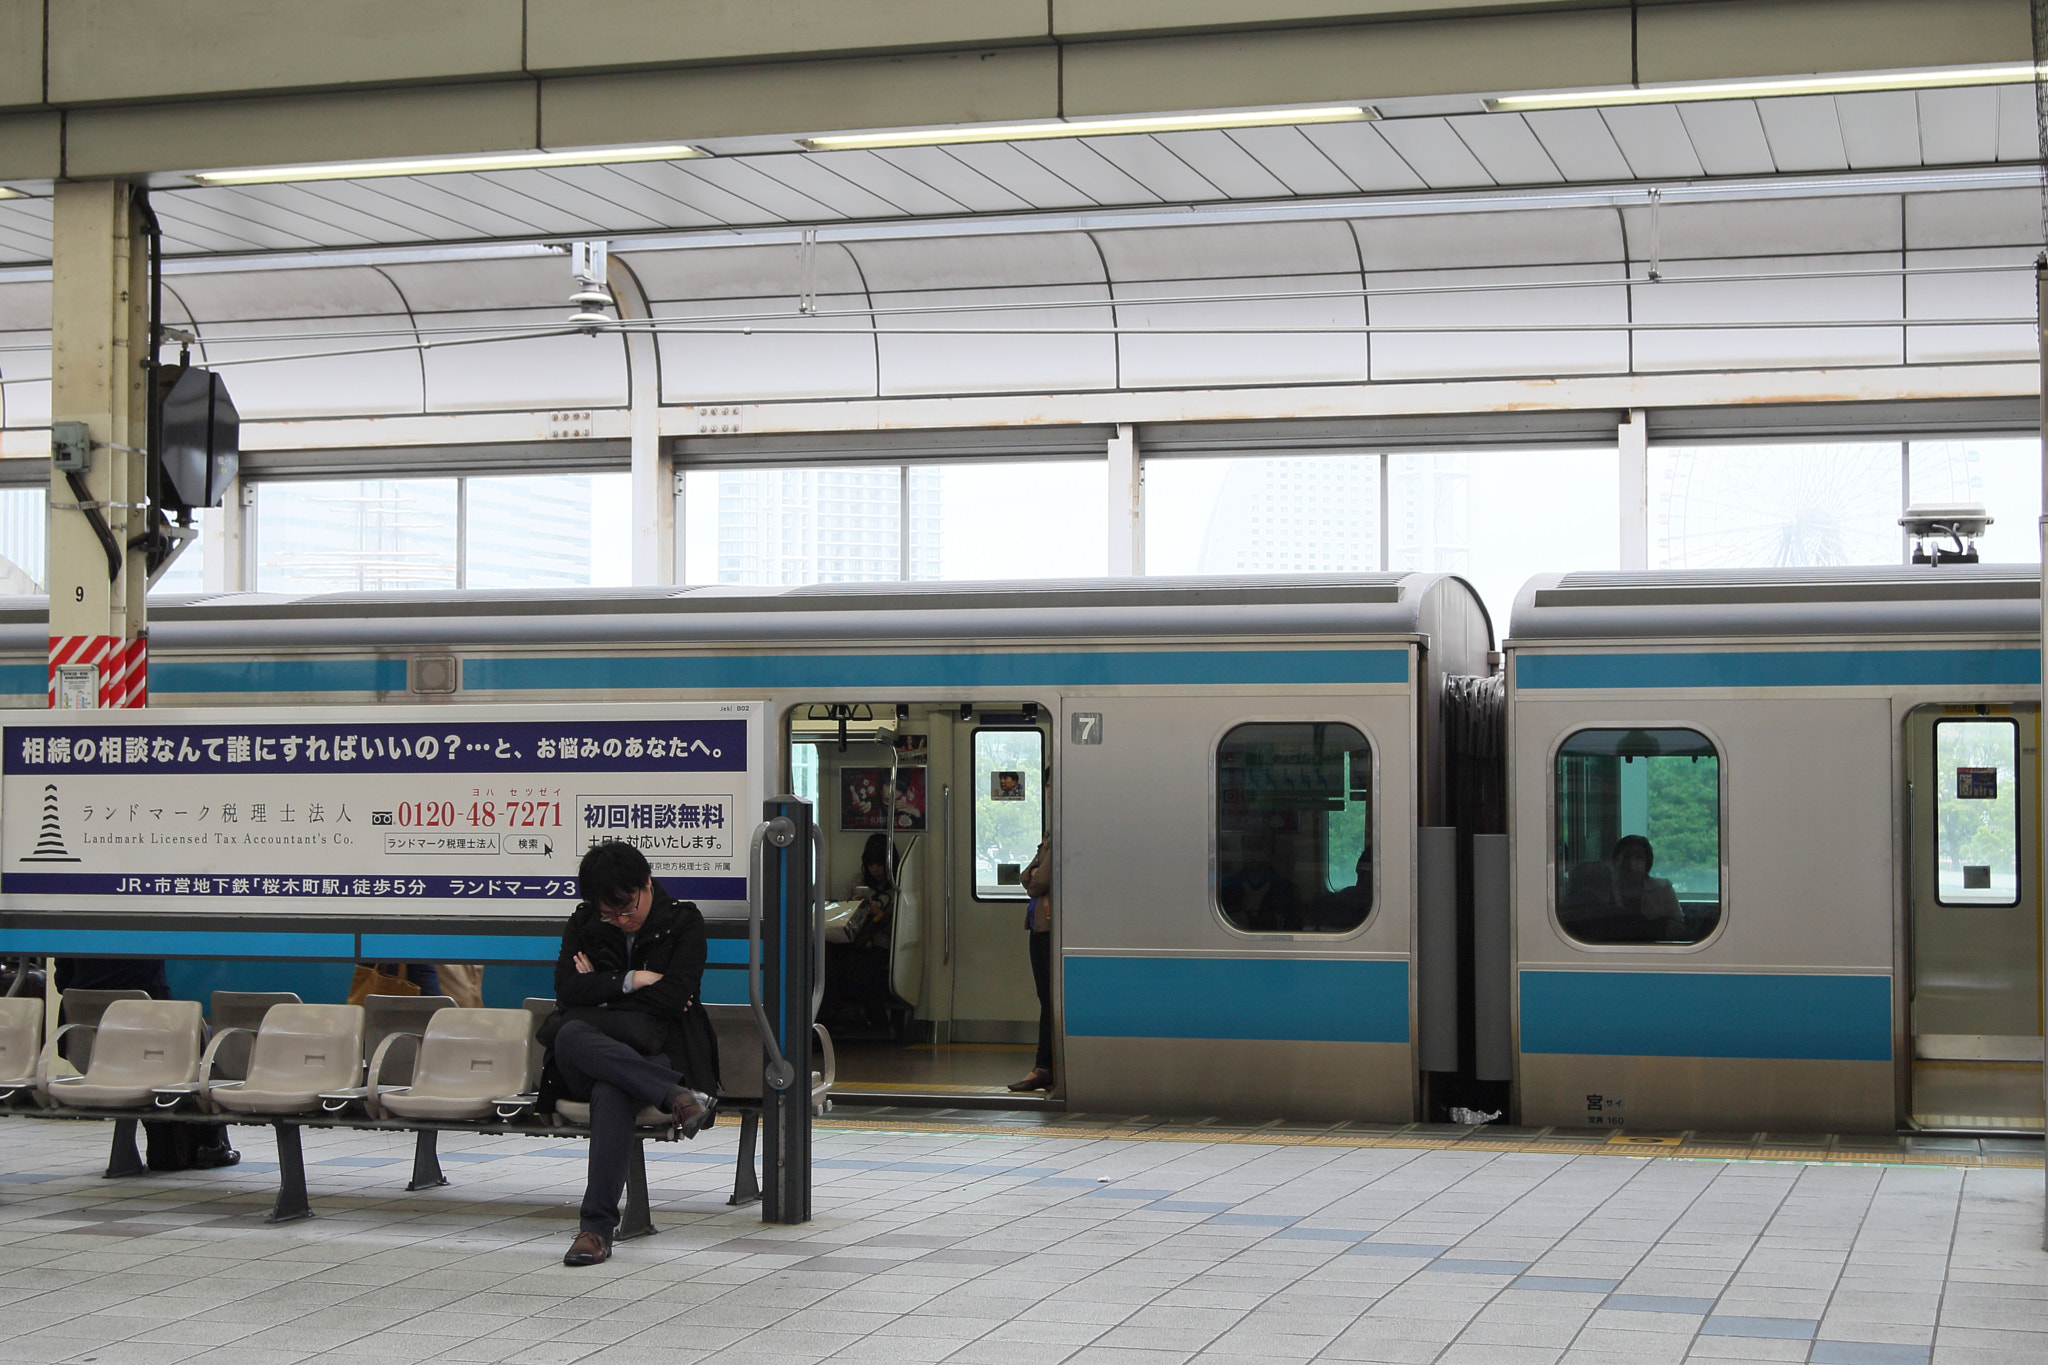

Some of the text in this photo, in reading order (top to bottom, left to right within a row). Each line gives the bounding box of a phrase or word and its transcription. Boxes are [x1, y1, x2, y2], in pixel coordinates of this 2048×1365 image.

[75, 585, 85, 603] 9
[1079, 717, 1096, 740] 7
[472, 787, 495, 797] ヨハ
[83, 802, 352, 824] ランドマーク税理士法人
[398, 801, 563, 827] 0120-48-7271
[583, 803, 725, 829] 初回相談無料
[83, 832, 354, 845] Landmark Licensed Tax Accountant's Co.
[387, 838, 497, 850] ランドマーク税理士法人
[518, 838, 539, 850] 検索
[449, 879, 576, 896] ランドマーク3
[1586, 1093, 1603, 1111] 宮
[1607, 1116, 1625, 1125] 160
